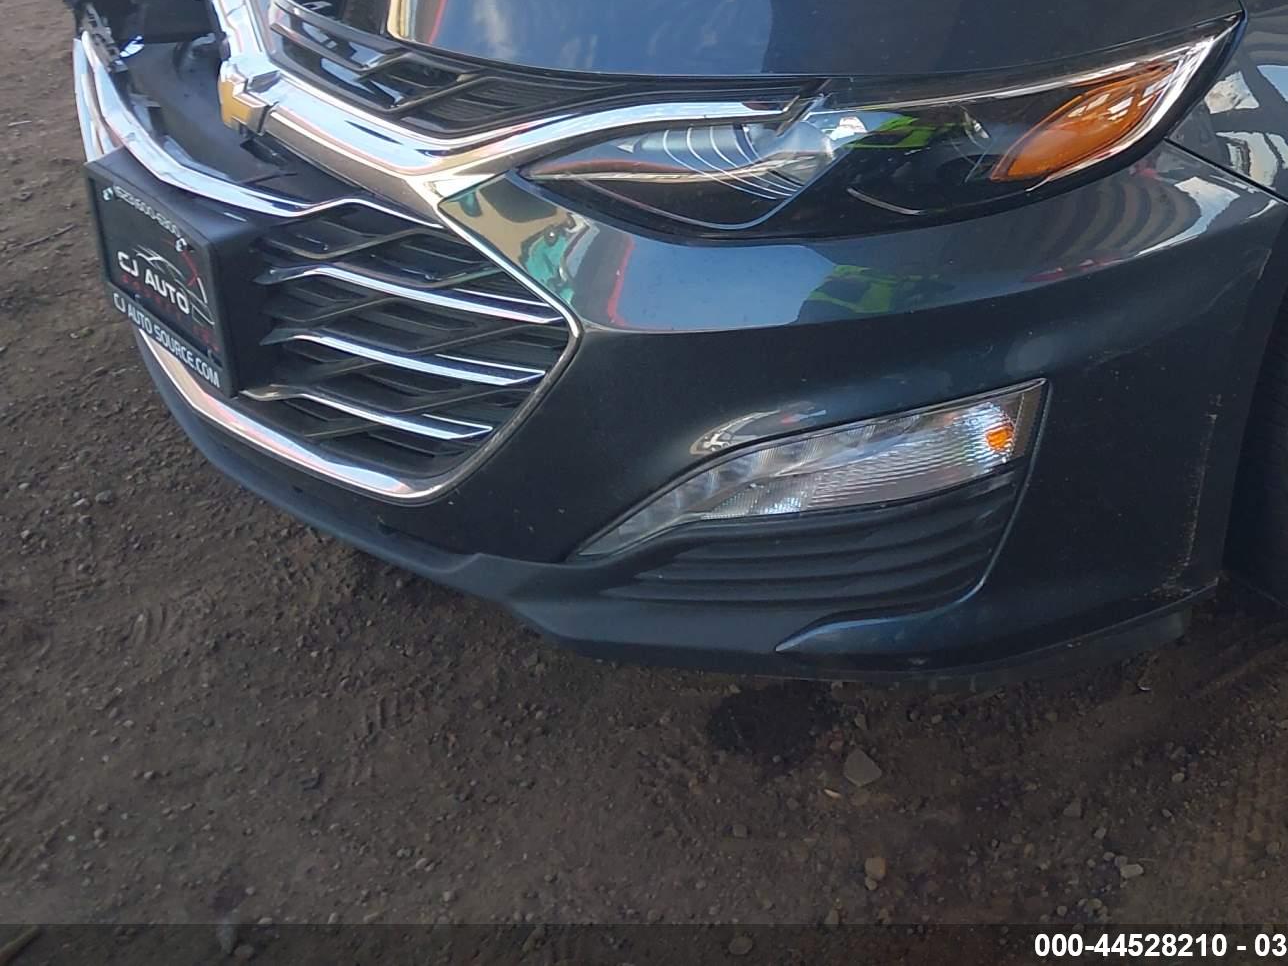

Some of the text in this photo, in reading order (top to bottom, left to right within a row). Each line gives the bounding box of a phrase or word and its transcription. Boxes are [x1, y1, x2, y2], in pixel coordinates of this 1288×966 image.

[117, 250, 139, 278] CJ
[144, 268, 190, 315] AUTO
[113, 292, 127, 314] CJ
[127, 304, 153, 335] AUTO
